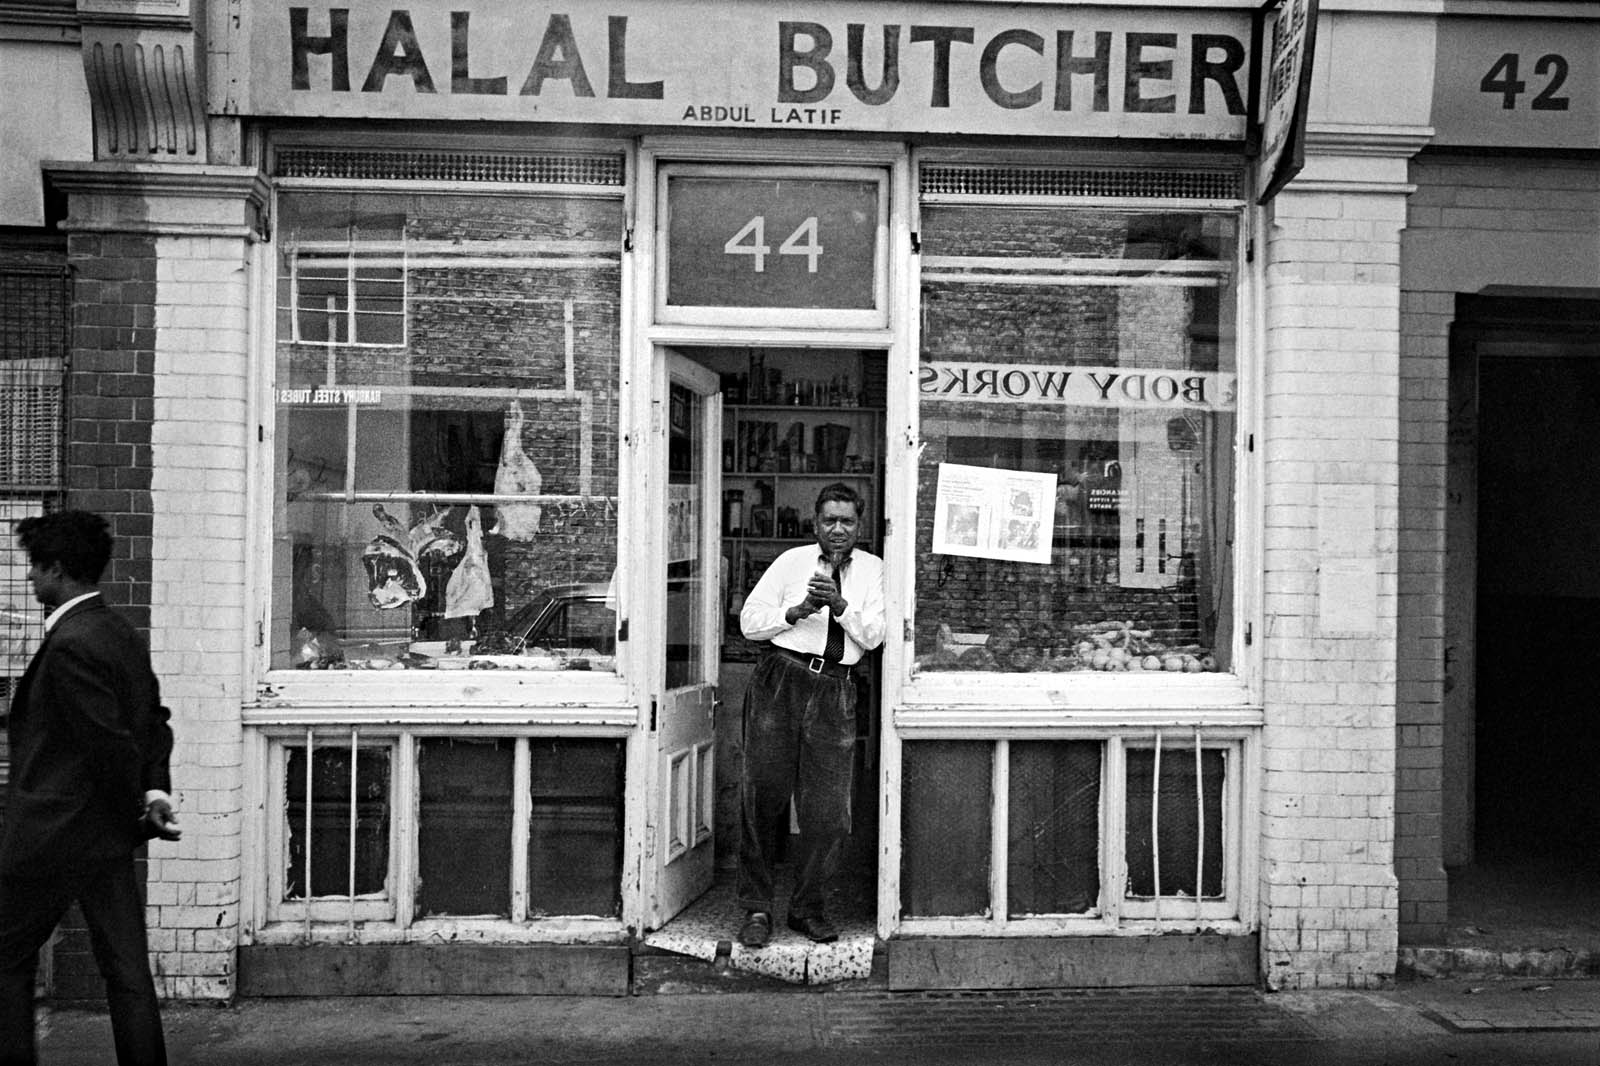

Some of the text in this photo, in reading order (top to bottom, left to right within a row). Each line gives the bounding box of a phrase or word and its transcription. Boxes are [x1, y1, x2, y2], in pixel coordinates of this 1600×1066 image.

[288, 6, 1247, 116] HALAL BUTCHER
[1479, 53, 1570, 110] 42
[682, 105, 842, 125] ABDUL LATIF
[723, 214, 824, 274] 44
